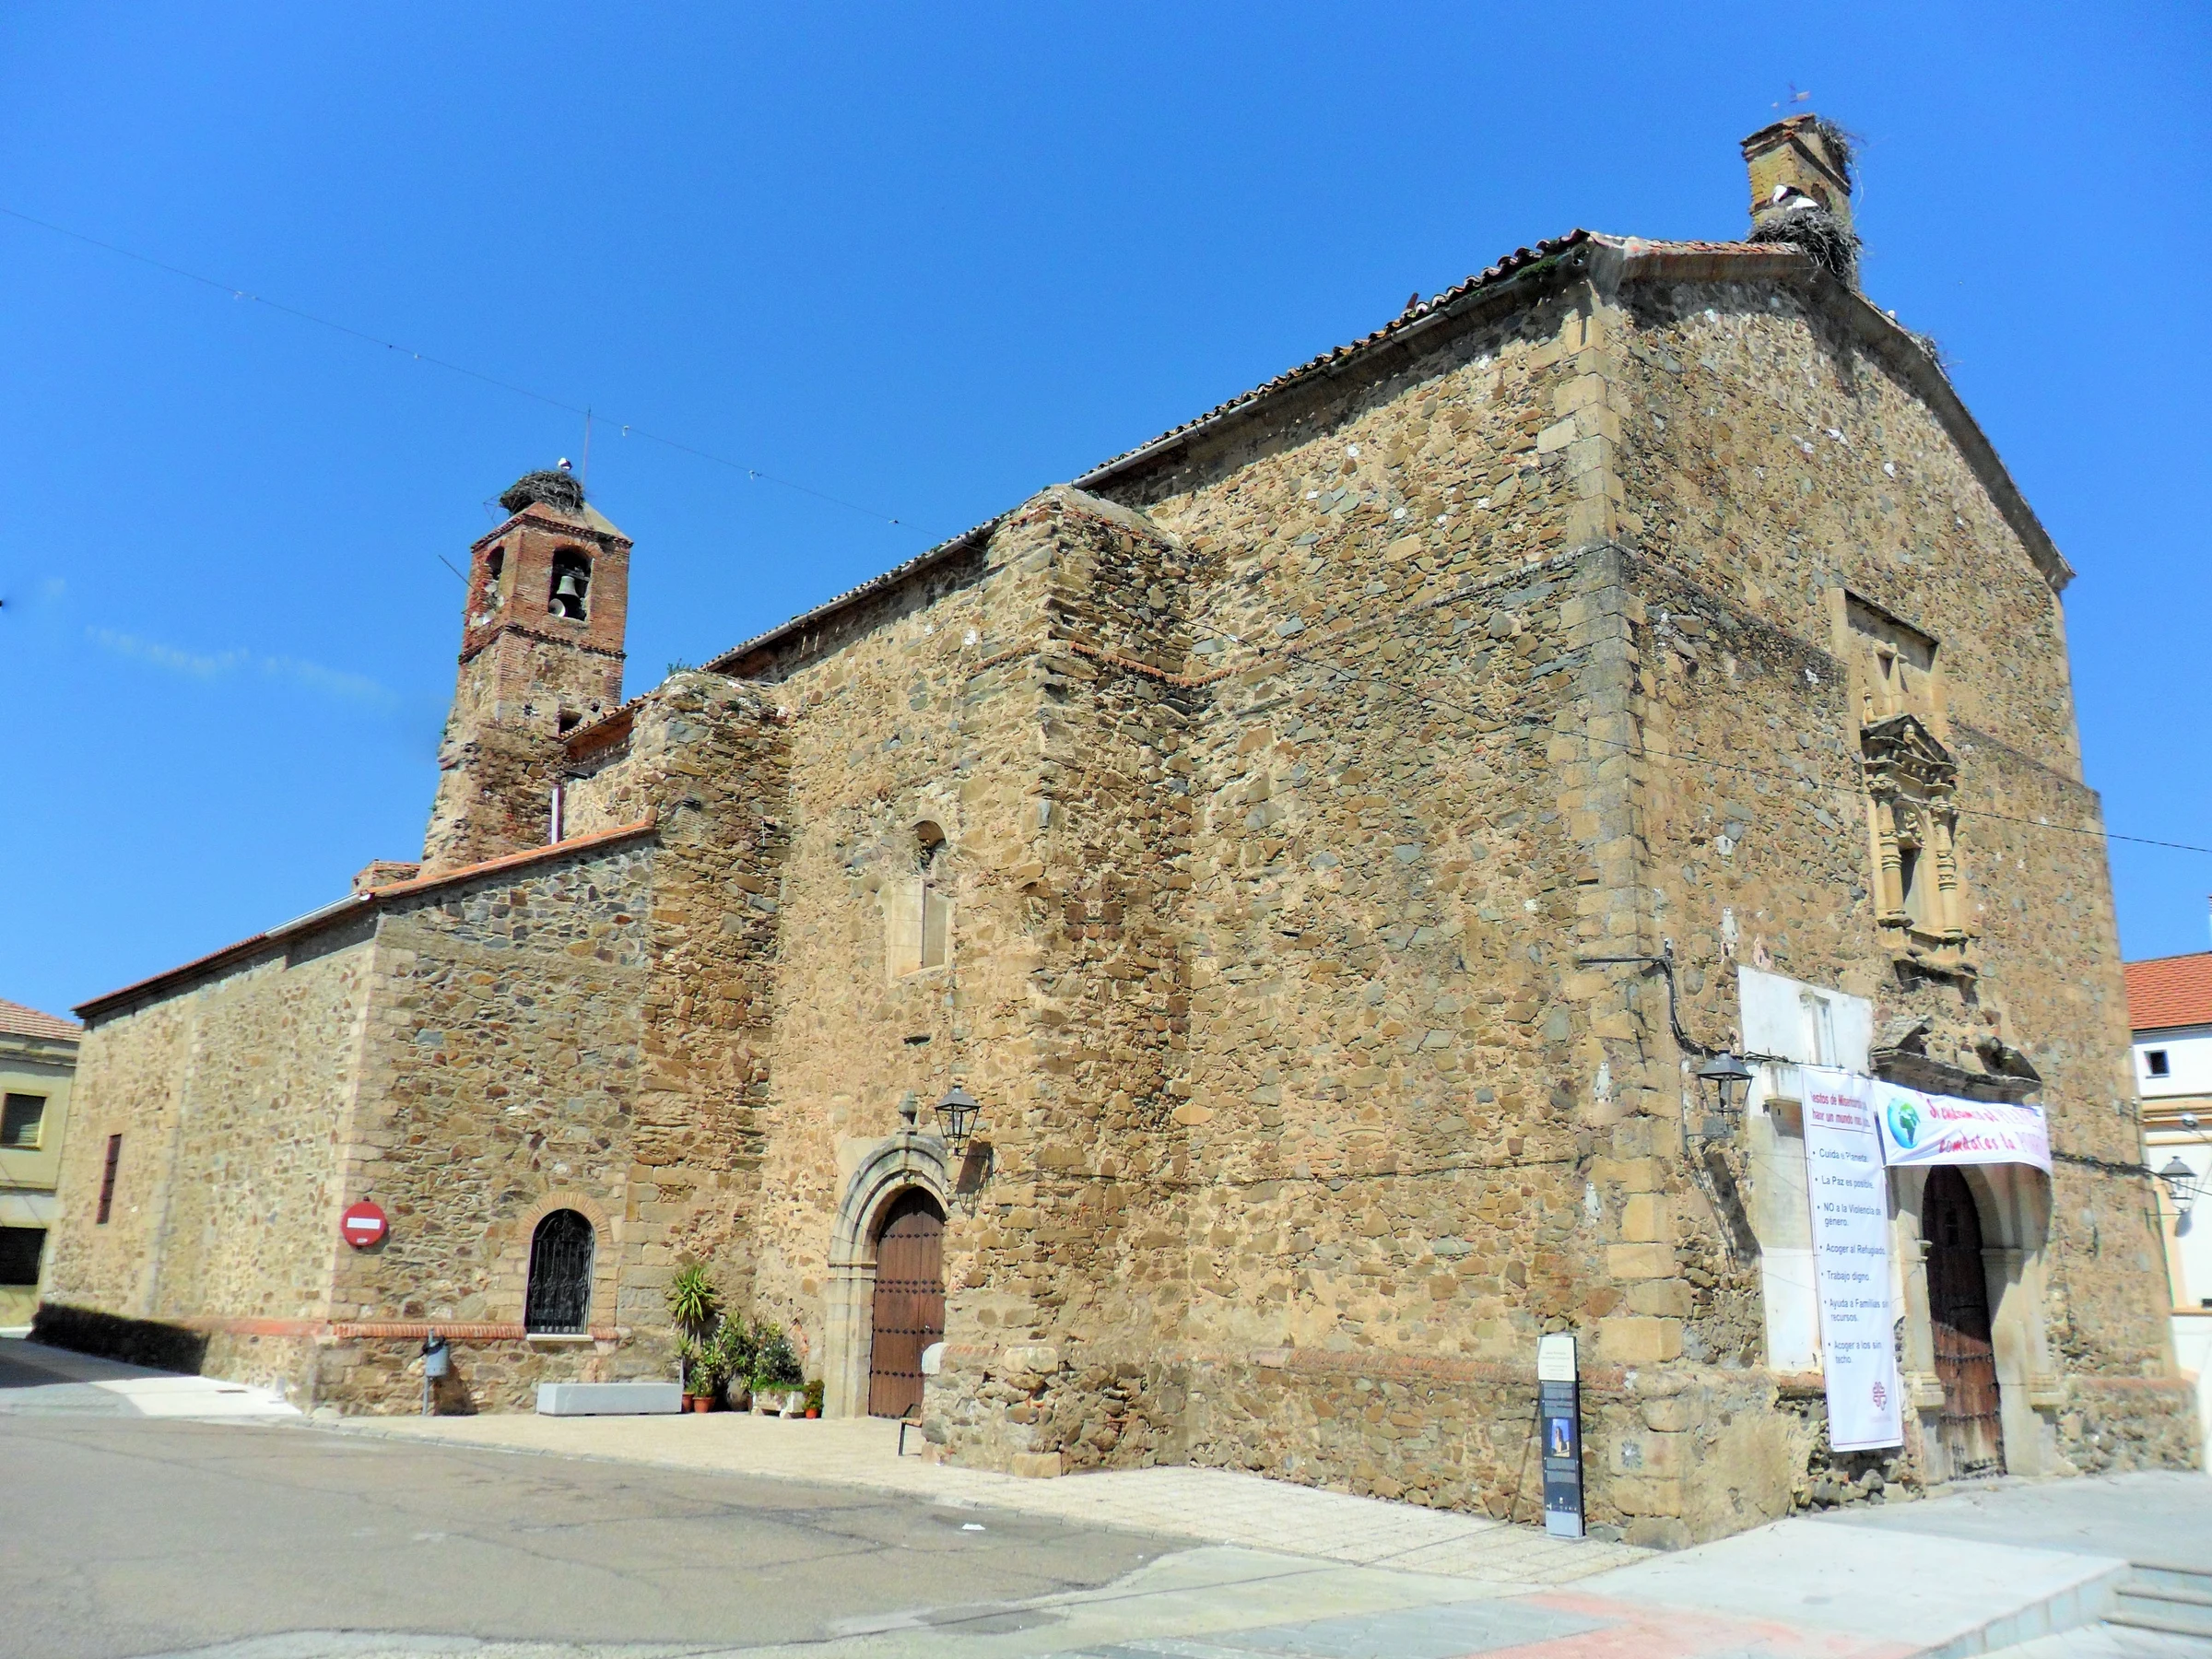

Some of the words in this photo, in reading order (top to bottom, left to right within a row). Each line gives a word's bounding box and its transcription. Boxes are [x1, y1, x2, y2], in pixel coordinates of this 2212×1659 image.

[1819, 1148, 1840, 1159] Cuida
[1821, 1175, 1830, 1184] La
[1832, 1176, 1844, 1186] Paz
[1824, 1203, 1835, 1212] NO
[1841, 1204, 1848, 1213] la
[1849, 1205, 1875, 1215] Violencia
[1826, 1243, 1849, 1255] Acoger
[1850, 1243, 1856, 1253] al
[1827, 1270, 1850, 1282] Trabajo
[1830, 1299, 1848, 1310] Ayuda
[1855, 1299, 1881, 1309] Familias
[1834, 1341, 1854, 1352] Acoger
[1861, 1341, 1871, 1349] los
[1873, 1340, 1882, 1349] sin
